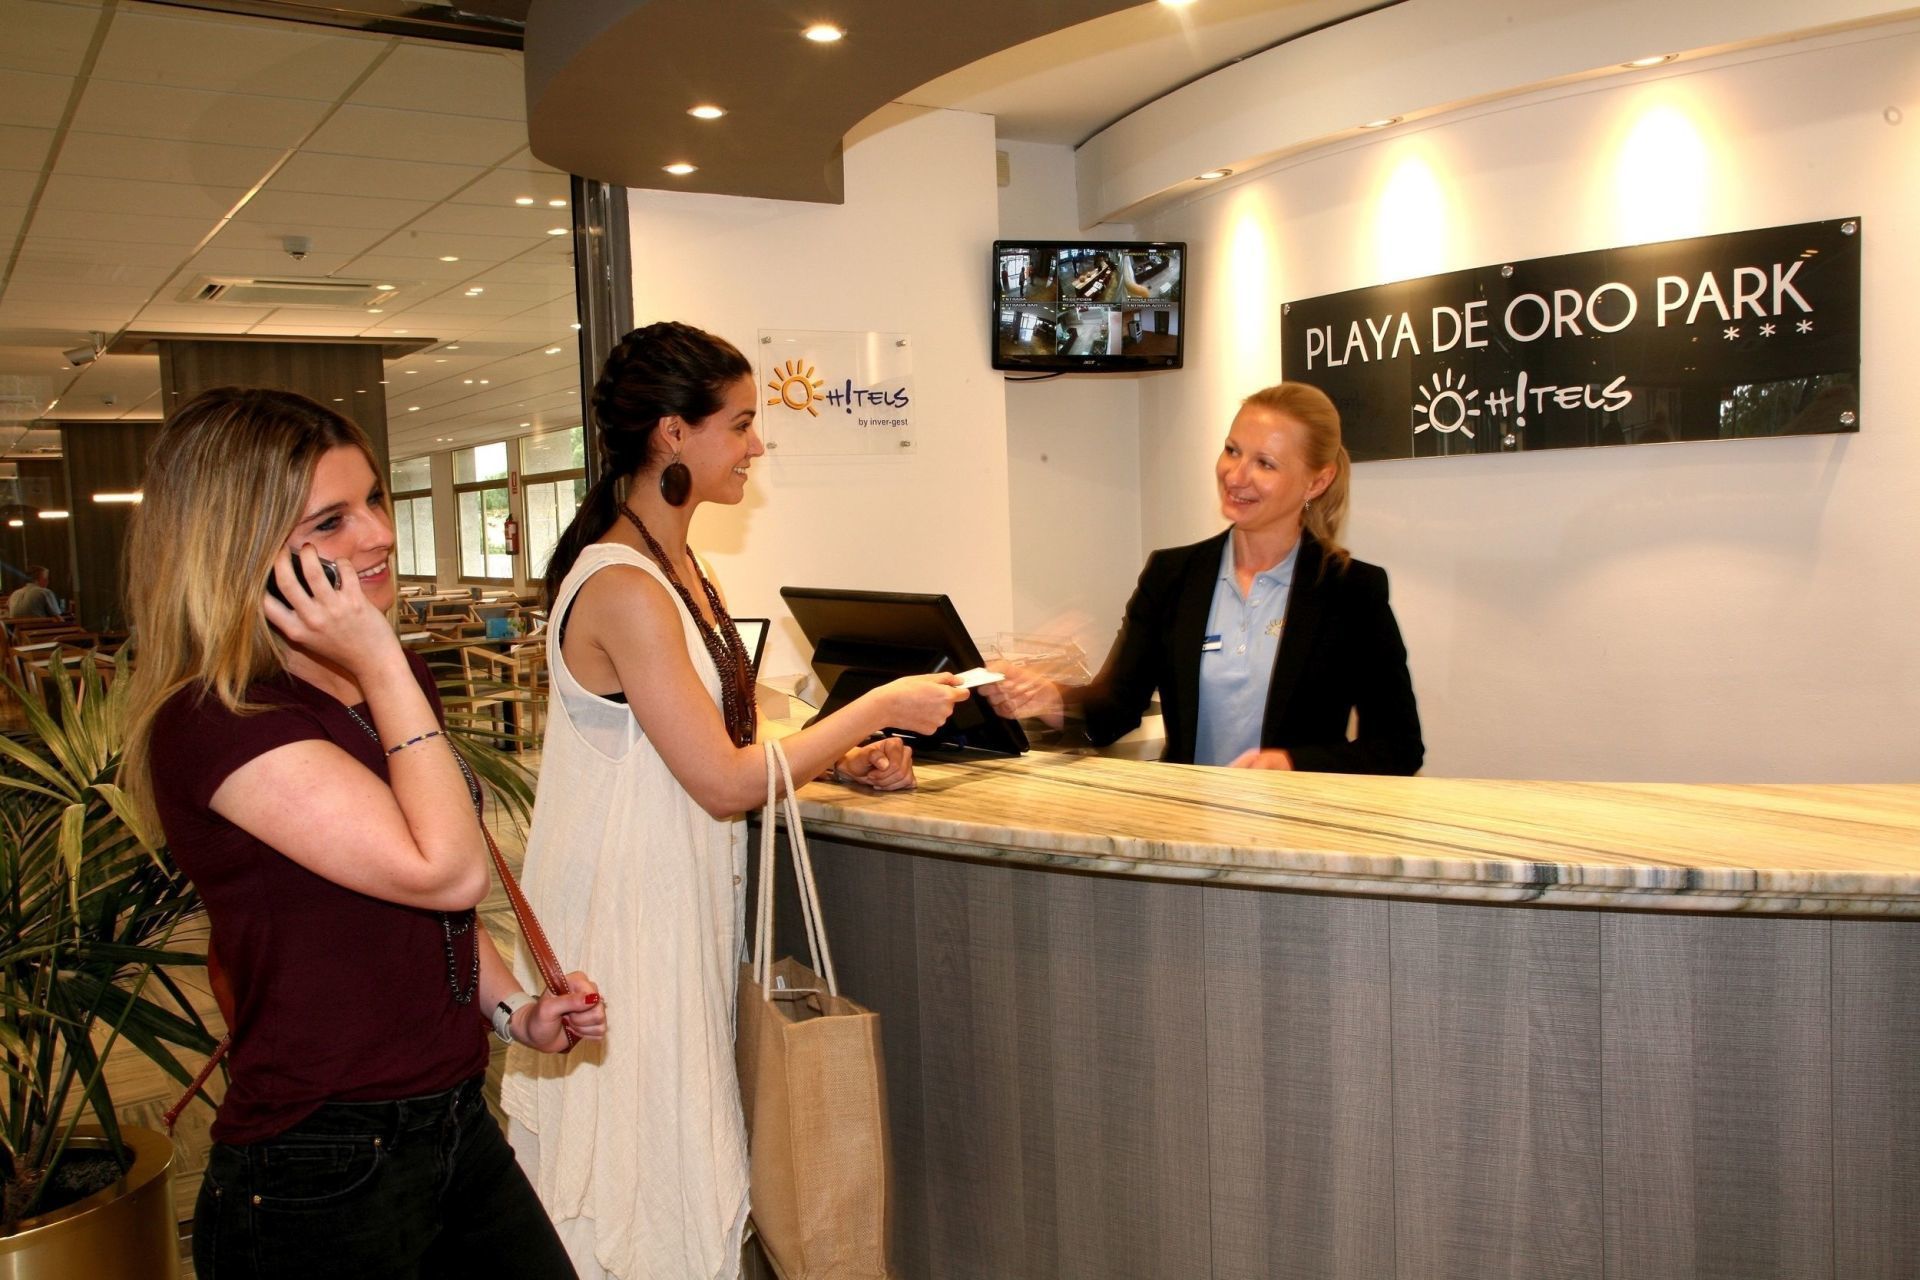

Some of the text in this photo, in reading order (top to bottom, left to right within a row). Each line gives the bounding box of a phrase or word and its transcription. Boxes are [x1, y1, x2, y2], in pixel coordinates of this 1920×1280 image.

[1306, 260, 1813, 370] PLAYA DE ORO PARK
[858, 418, 909, 428] by inver-gest
